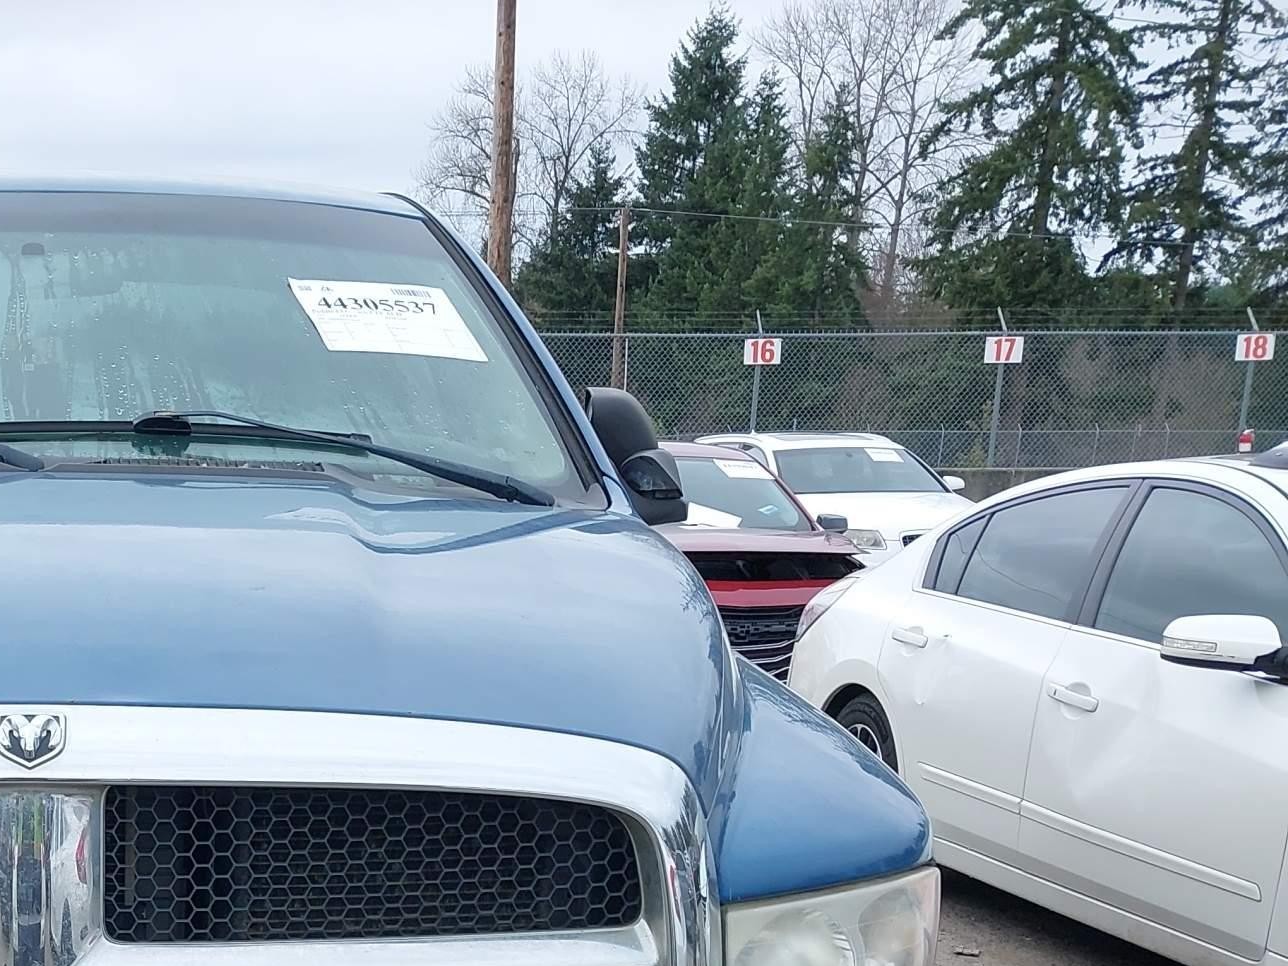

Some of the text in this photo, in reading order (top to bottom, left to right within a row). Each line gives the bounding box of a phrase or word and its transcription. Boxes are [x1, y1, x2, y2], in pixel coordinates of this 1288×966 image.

[318, 297, 436, 315] 44305537
[751, 340, 775, 363] 16
[994, 338, 1017, 362] 17
[1243, 335, 1268, 359] 18
